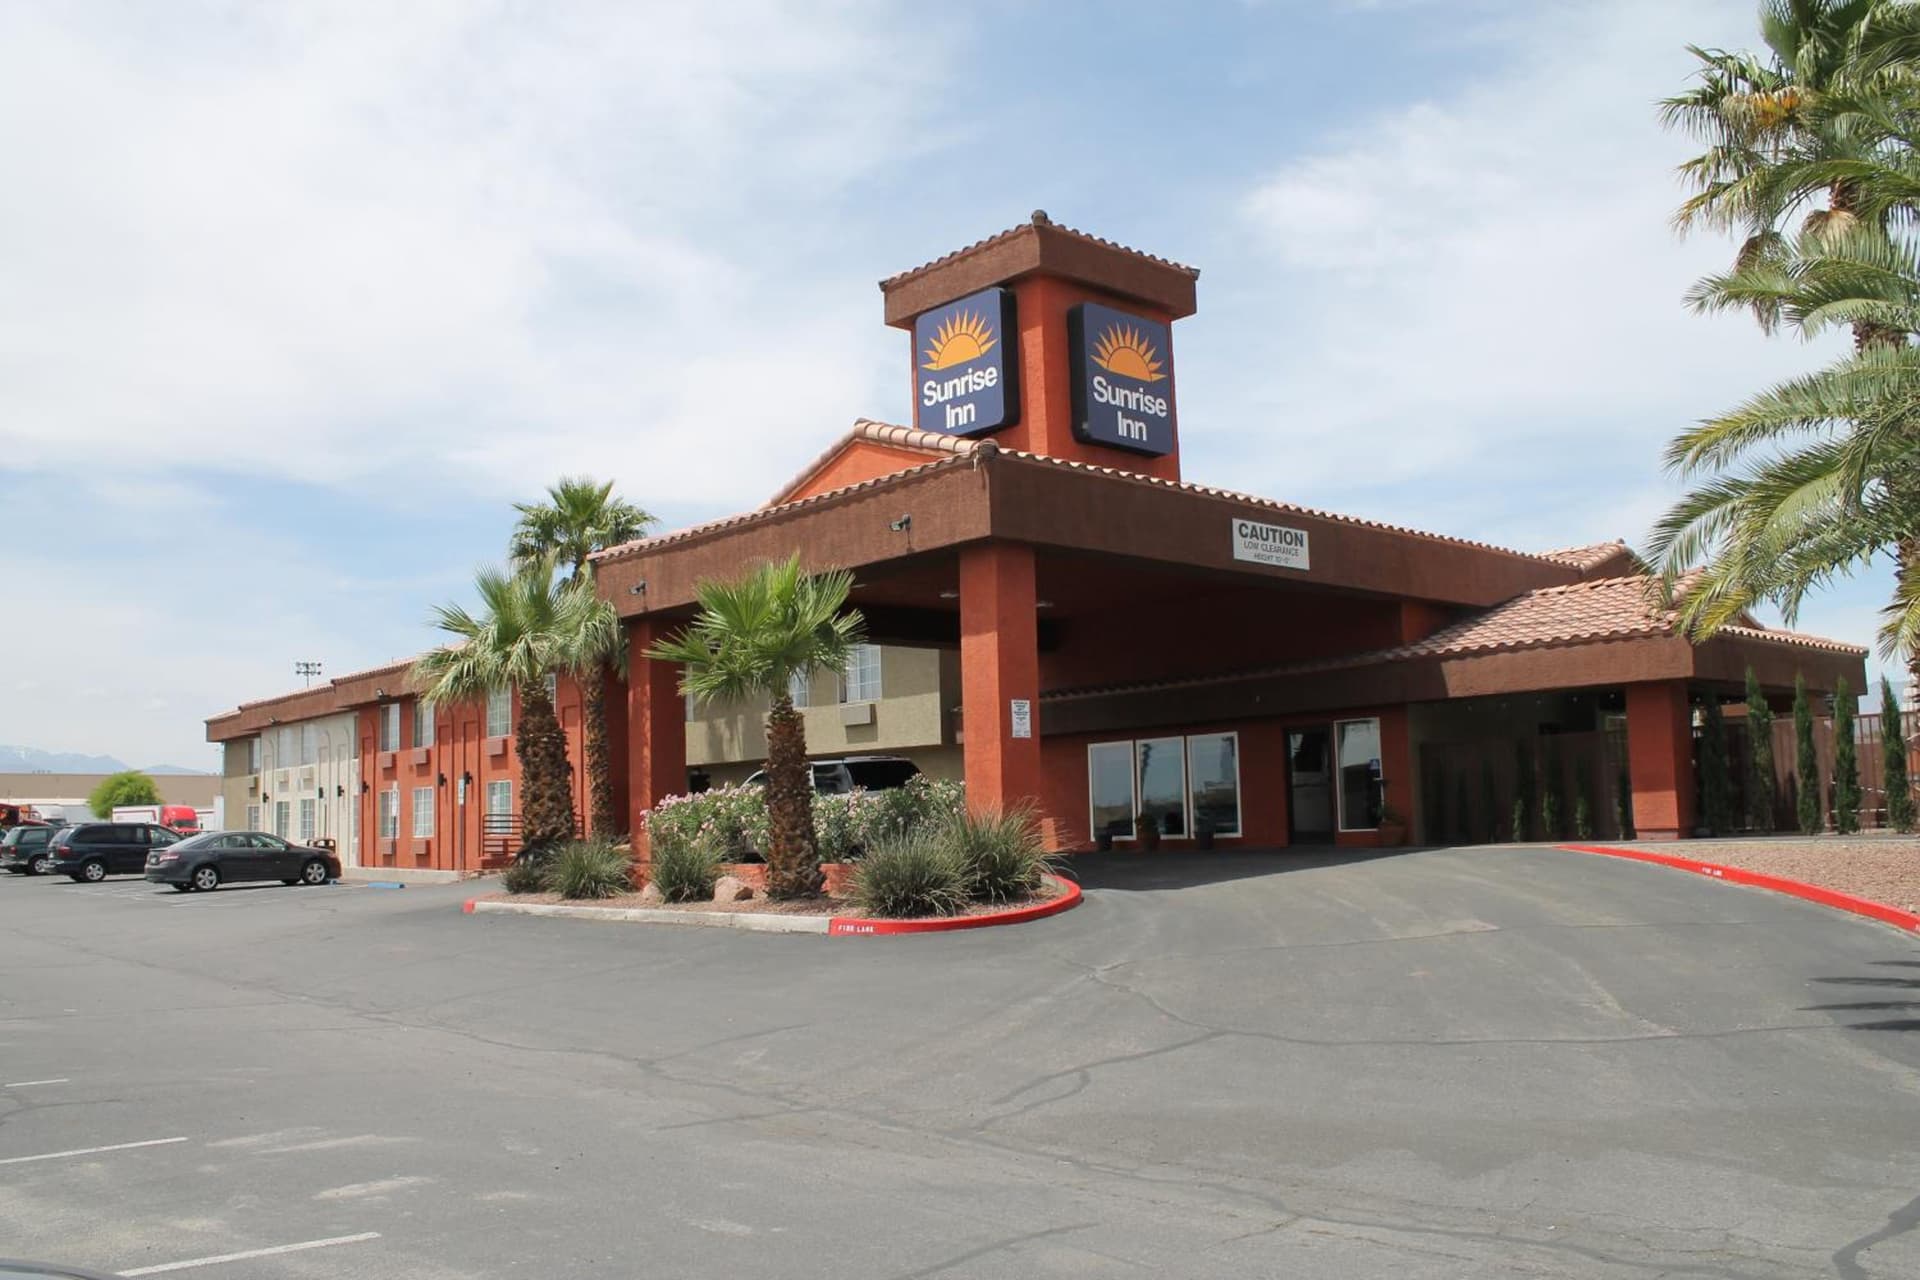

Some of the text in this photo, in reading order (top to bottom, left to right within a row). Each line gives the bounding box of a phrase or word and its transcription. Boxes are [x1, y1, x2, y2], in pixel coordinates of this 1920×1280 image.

[923, 366, 998, 407] Sunrise
[1092, 377, 1168, 417] Sunrise
[945, 402, 975, 429] Inn
[1117, 411, 1147, 441] Inn
[1239, 523, 1303, 547] CAUTION
[1243, 540, 1300, 557] LOW CLEARANCE
